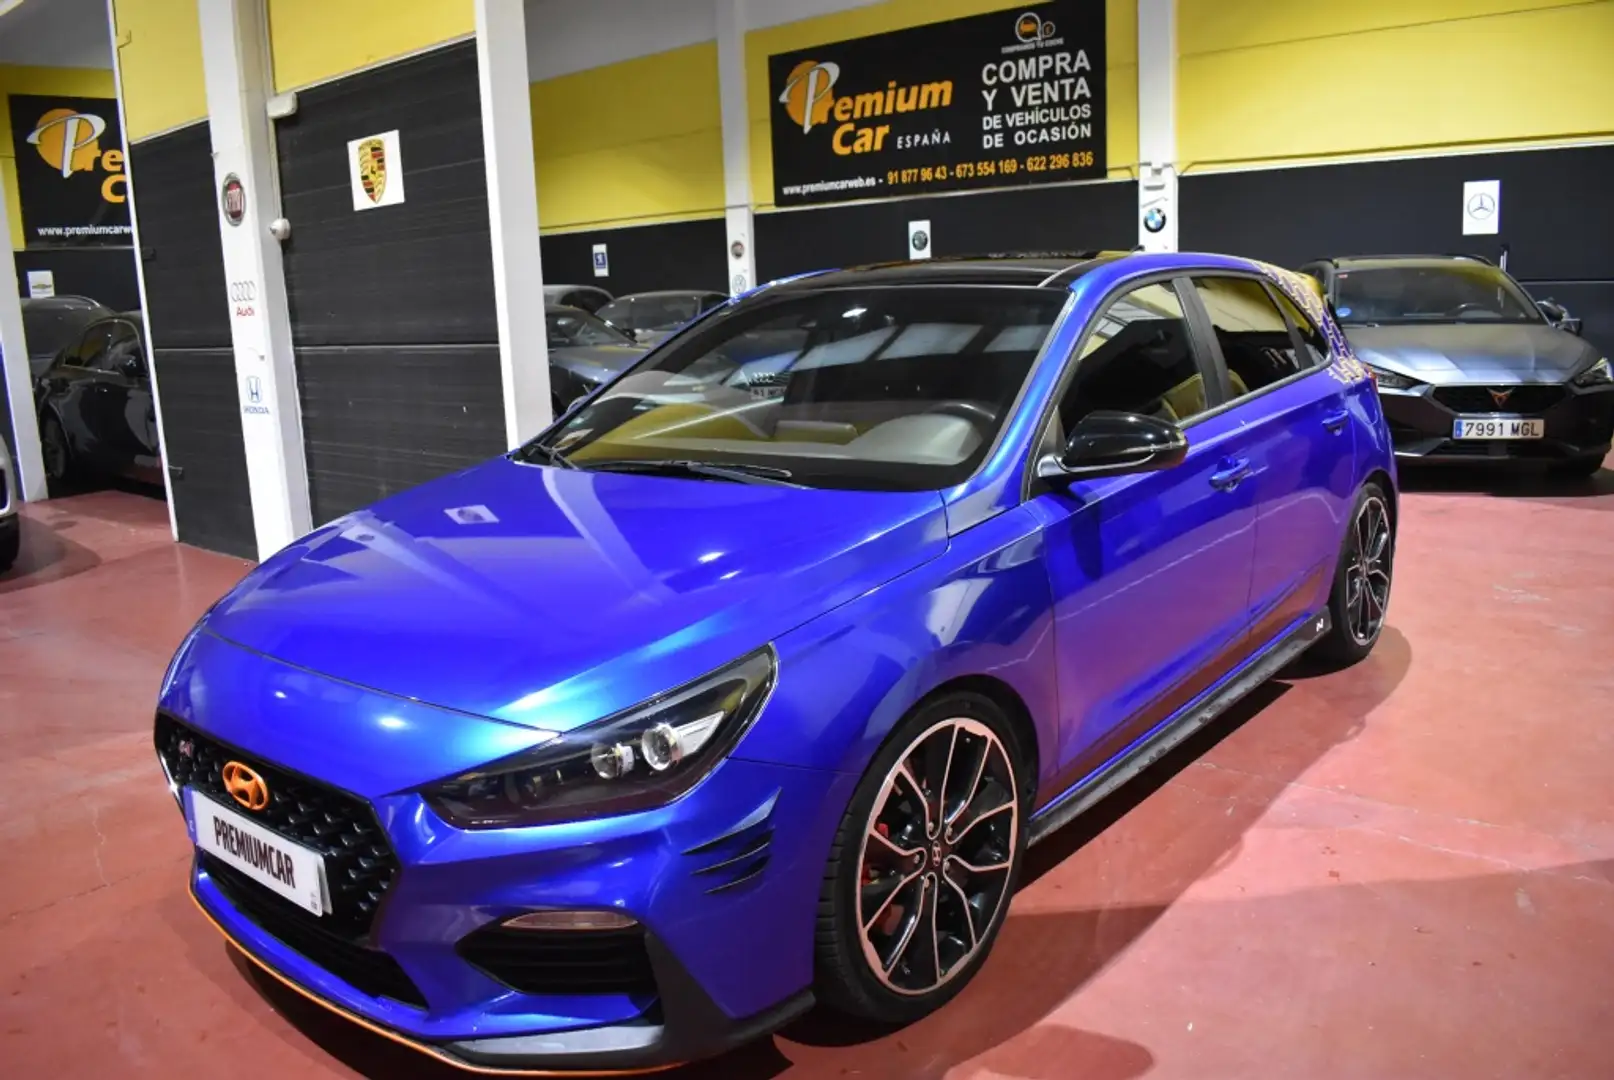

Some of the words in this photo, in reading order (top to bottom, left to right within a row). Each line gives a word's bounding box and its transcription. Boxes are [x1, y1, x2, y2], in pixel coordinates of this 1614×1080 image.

[982, 49, 1091, 86] COMPRA
[779, 61, 953, 135] Premium
[982, 88, 998, 112] Y
[1010, 76, 1092, 108] VENTA
[982, 115, 1002, 131] DE
[1005, 103, 1092, 128] VEHÍCULOS
[832, 122, 890, 156] Car
[896, 129, 952, 150] ESPAÑA
[983, 133, 1004, 149] DE
[1014, 122, 1092, 146] OCASIÓN
[782, 176, 876, 196] www.premiumcarweb.es
[887, 170, 899, 185] 91
[901, 168, 919, 184] 877
[921, 167, 933, 181] 96
[935, 165, 947, 180] 43
[955, 162, 975, 178] 673
[977, 160, 996, 176] 554
[1026, 156, 1047, 172] 622
[1049, 153, 1070, 170] 296
[1072, 151, 1094, 168] 836
[236, 306, 255, 317] Audi
[1465, 422, 1504, 437] 7991
[1511, 422, 1539, 437] MGL
[212, 815, 296, 889] PREMIUMCAR
